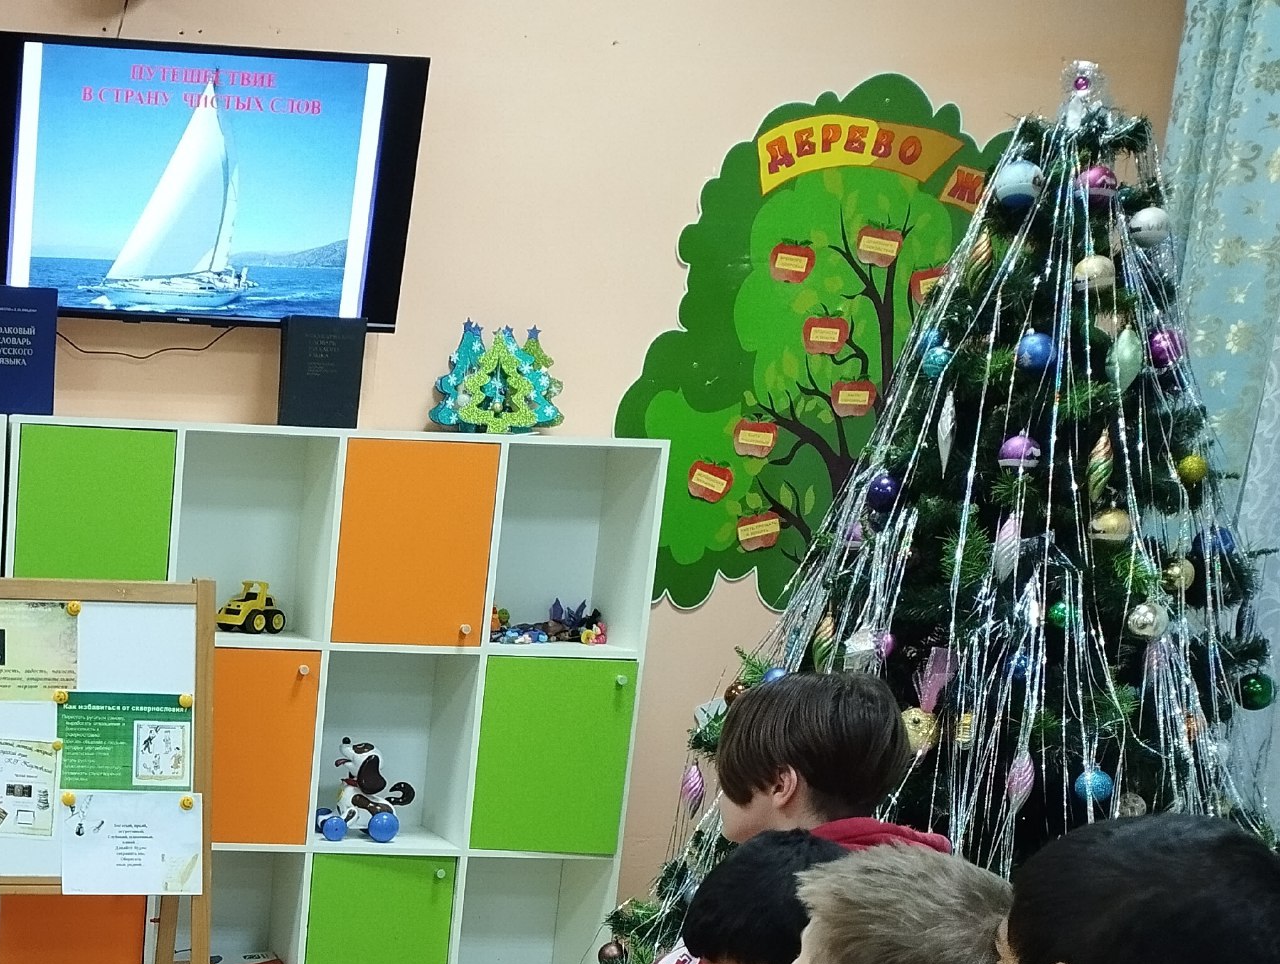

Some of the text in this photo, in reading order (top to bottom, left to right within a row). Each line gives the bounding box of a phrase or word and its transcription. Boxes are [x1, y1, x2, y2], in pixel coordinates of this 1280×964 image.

[130, 64, 277, 89] ПУТЕШЕСТВИЕ
[81, 87, 322, 115] В СТРАНУ ЧИСТЫХ СЛОВ
[766, 123, 923, 175] ДЕРЕВО
[948, 169, 985, 205] Ж
[0, 357, 27, 366] ЯЗЫКА
